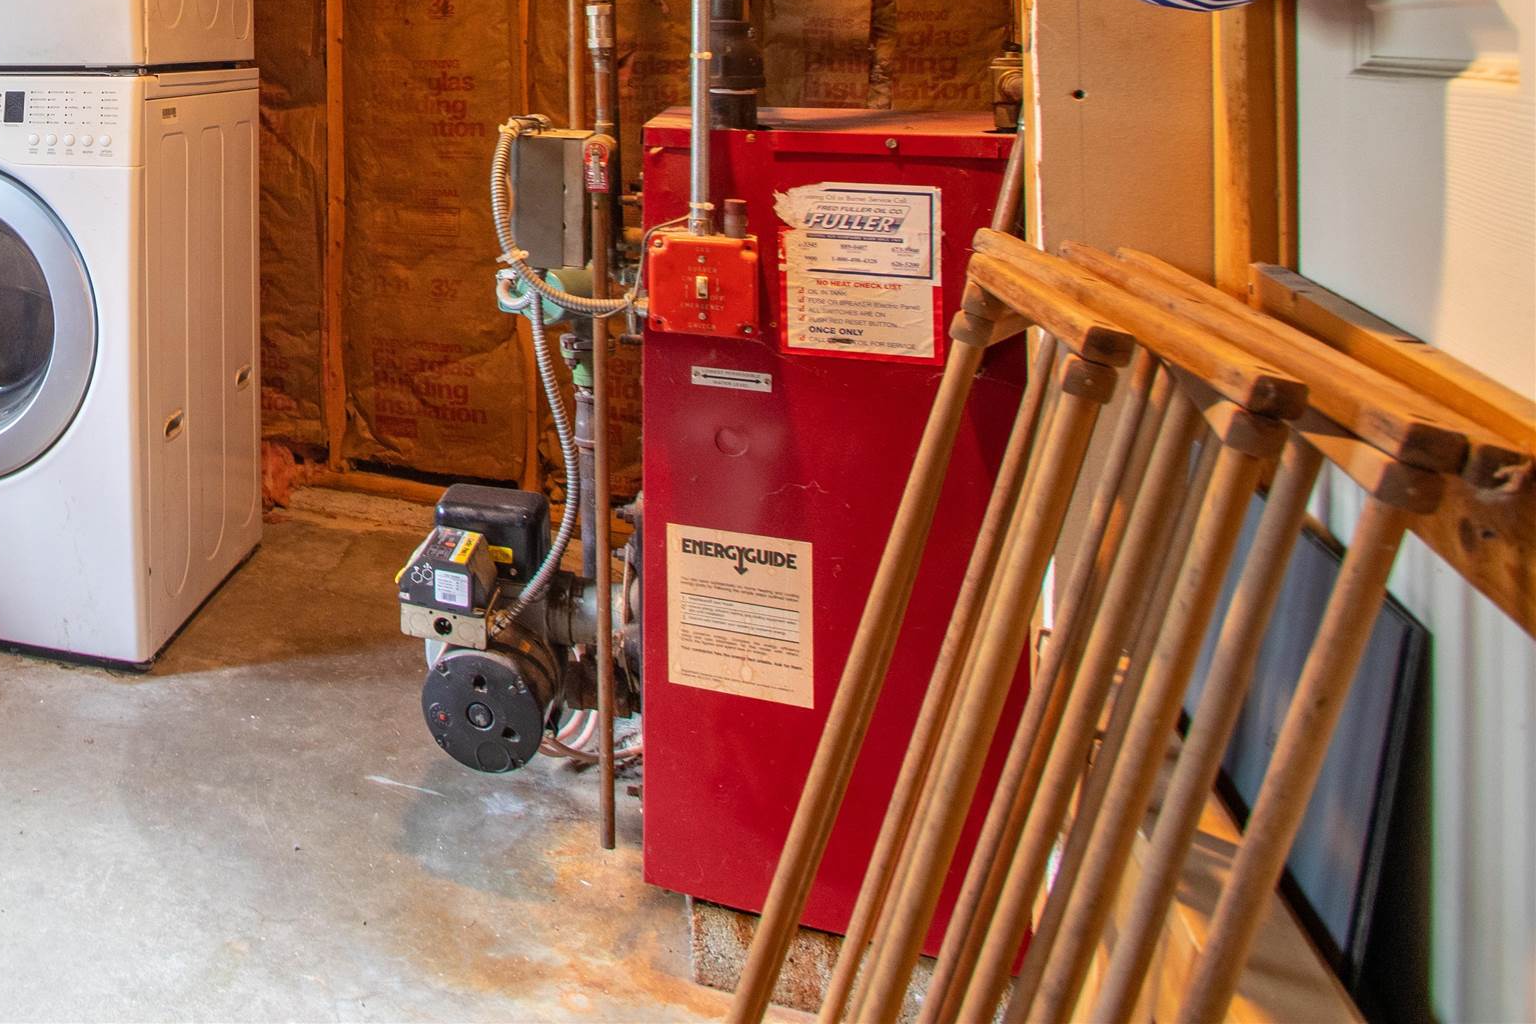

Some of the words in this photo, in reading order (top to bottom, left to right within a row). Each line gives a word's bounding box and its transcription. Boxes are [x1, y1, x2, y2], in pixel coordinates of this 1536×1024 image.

[808, 213, 896, 233] FULLER
[830, 280, 851, 288] HEAT
[680, 302, 724, 311] EMERGENCY
[808, 326, 836, 334] ONCE
[839, 327, 864, 336] ONLY
[681, 538, 797, 570] ENERGYGUIDE
